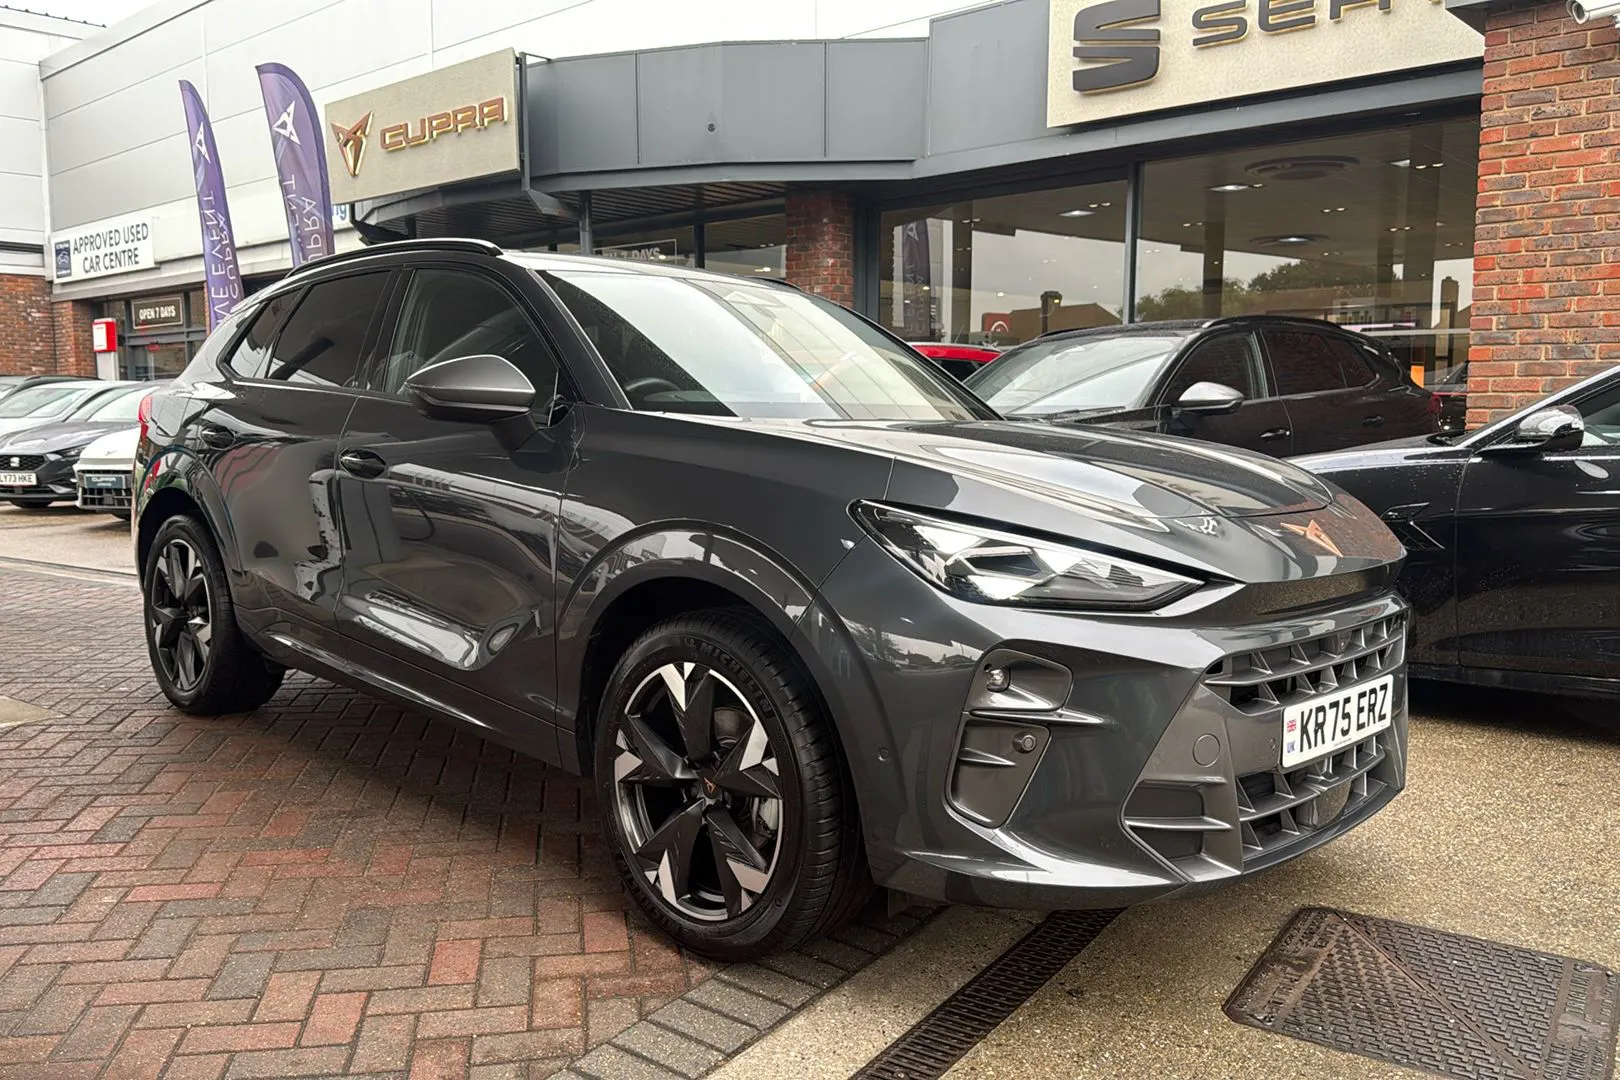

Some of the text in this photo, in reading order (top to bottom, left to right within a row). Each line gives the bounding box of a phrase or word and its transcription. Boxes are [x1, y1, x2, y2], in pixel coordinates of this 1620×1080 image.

[1191, 0, 1441, 47] SE
[380, 97, 506, 151] CUPRA
[73, 222, 149, 255] APPROVED USED
[631, 247, 660, 260] DAYS
[83, 247, 139, 273] CAR CENTRE
[138, 305, 176, 320] OPEN 7 DAYS
[1299, 682, 1389, 753] KR75 ERZ
